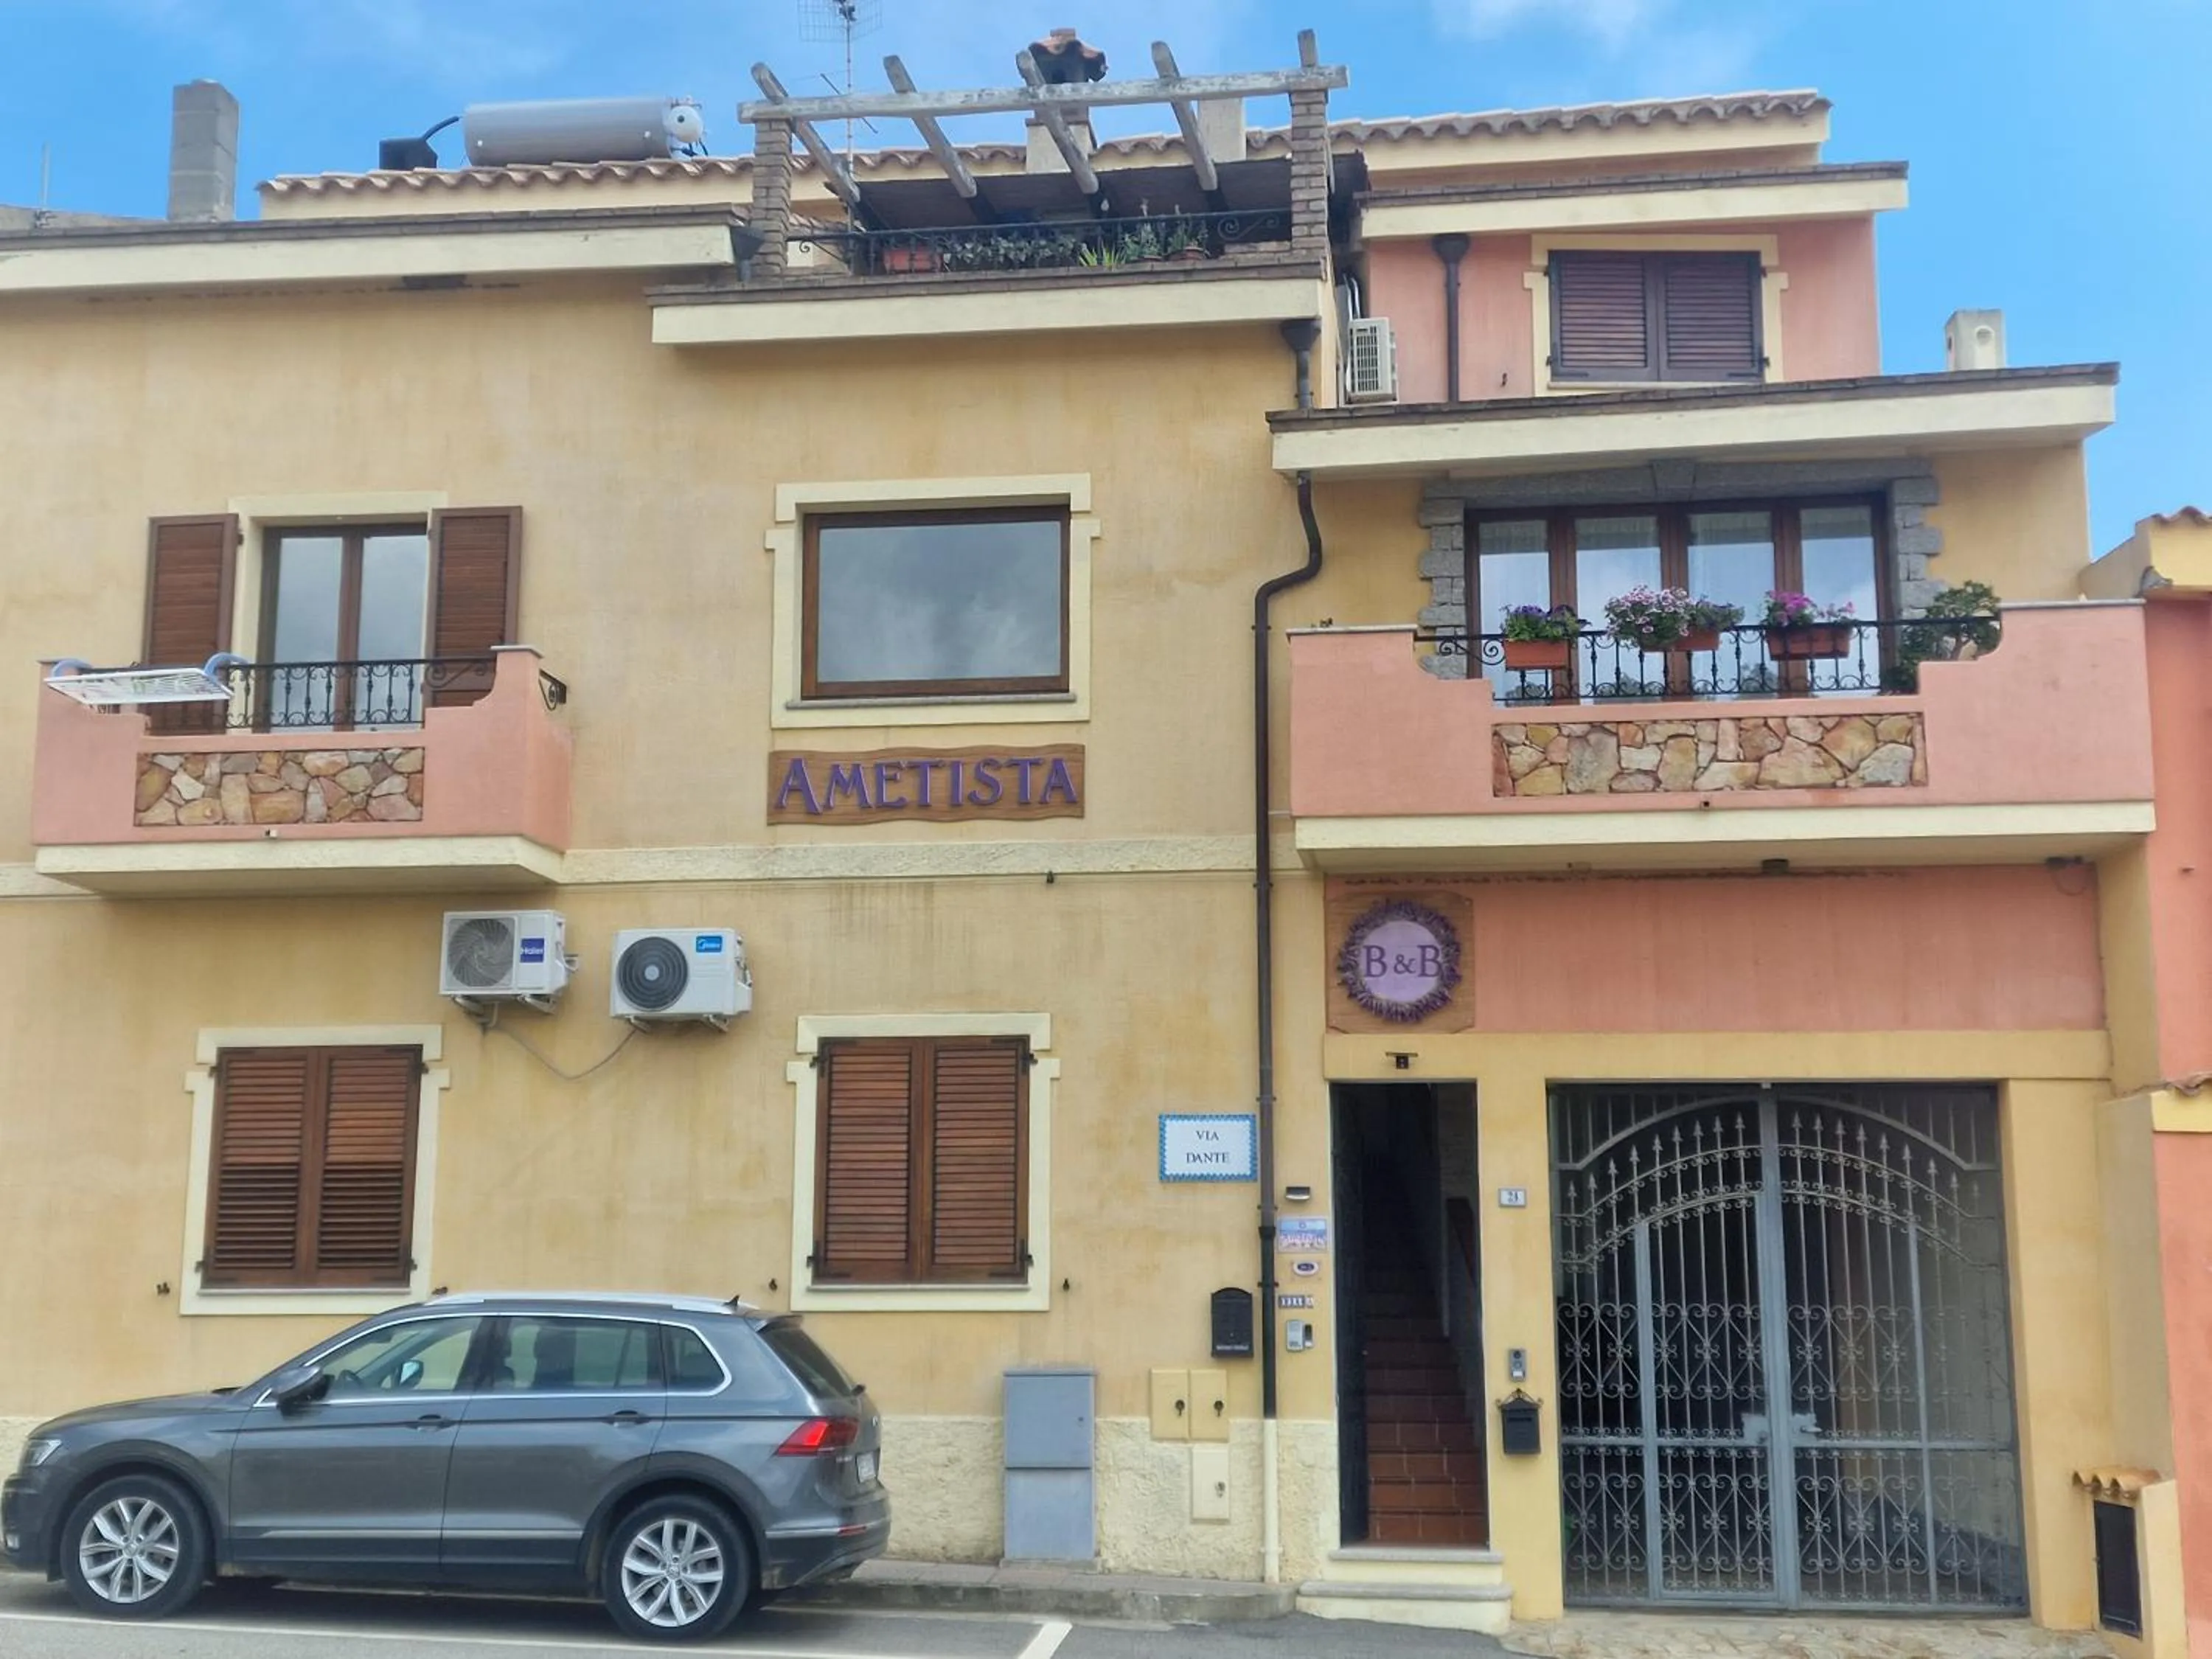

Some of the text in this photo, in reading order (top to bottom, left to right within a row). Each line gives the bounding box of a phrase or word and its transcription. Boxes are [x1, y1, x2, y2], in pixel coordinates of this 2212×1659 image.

[775, 757, 1078, 815] AMETISTA
[1363, 945, 1443, 978] B&B
[1196, 1130, 1220, 1141] VIA
[1186, 1152, 1229, 1164] DANTE
